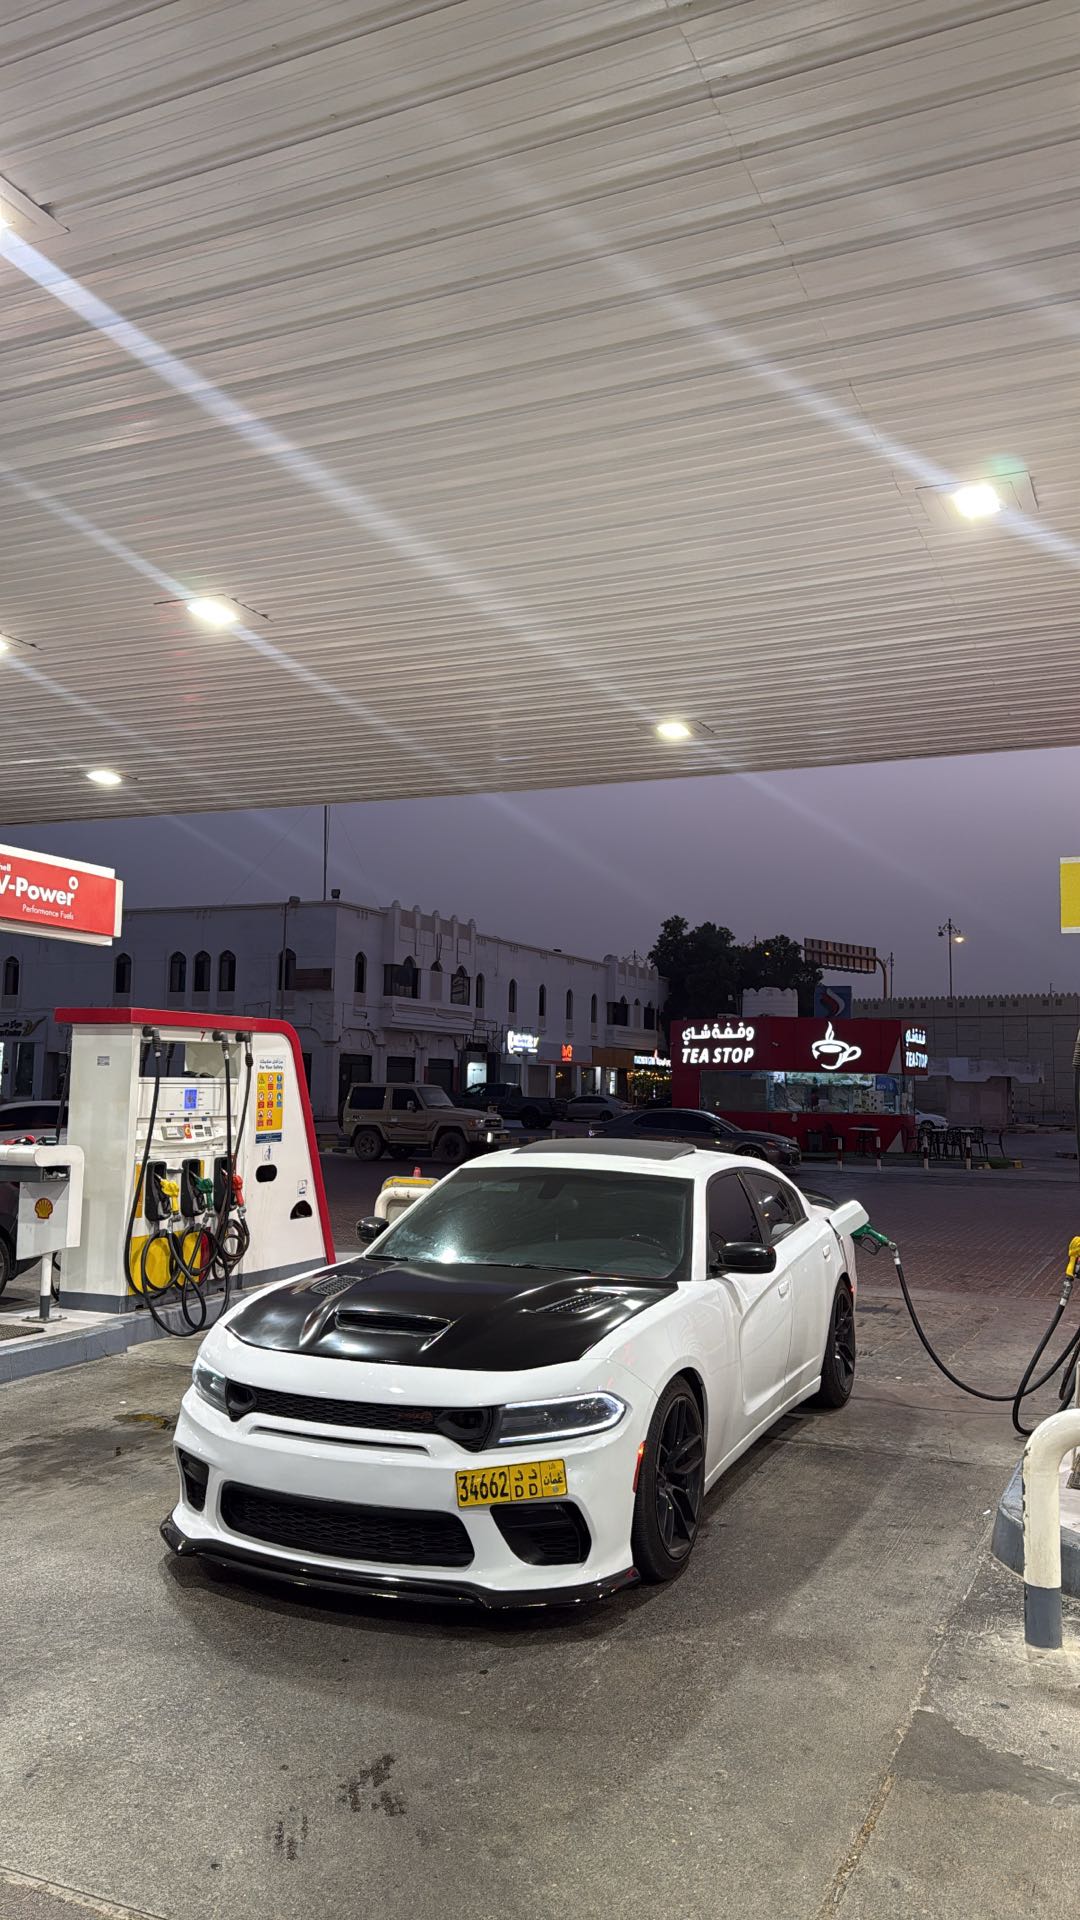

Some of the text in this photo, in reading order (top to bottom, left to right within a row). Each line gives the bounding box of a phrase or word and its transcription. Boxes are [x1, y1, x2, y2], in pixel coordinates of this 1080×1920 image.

[22, 904, 74, 920] Performance Fuels
[200, 1031, 206, 1040] 7
[681, 1021, 755, 1046] وقفة شاي
[681, 1047, 709, 1064] TEA
[712, 1047, 754, 1064] STOP
[905, 1051, 915, 1068] TEA
[458, 1471, 509, 1502] 34662
